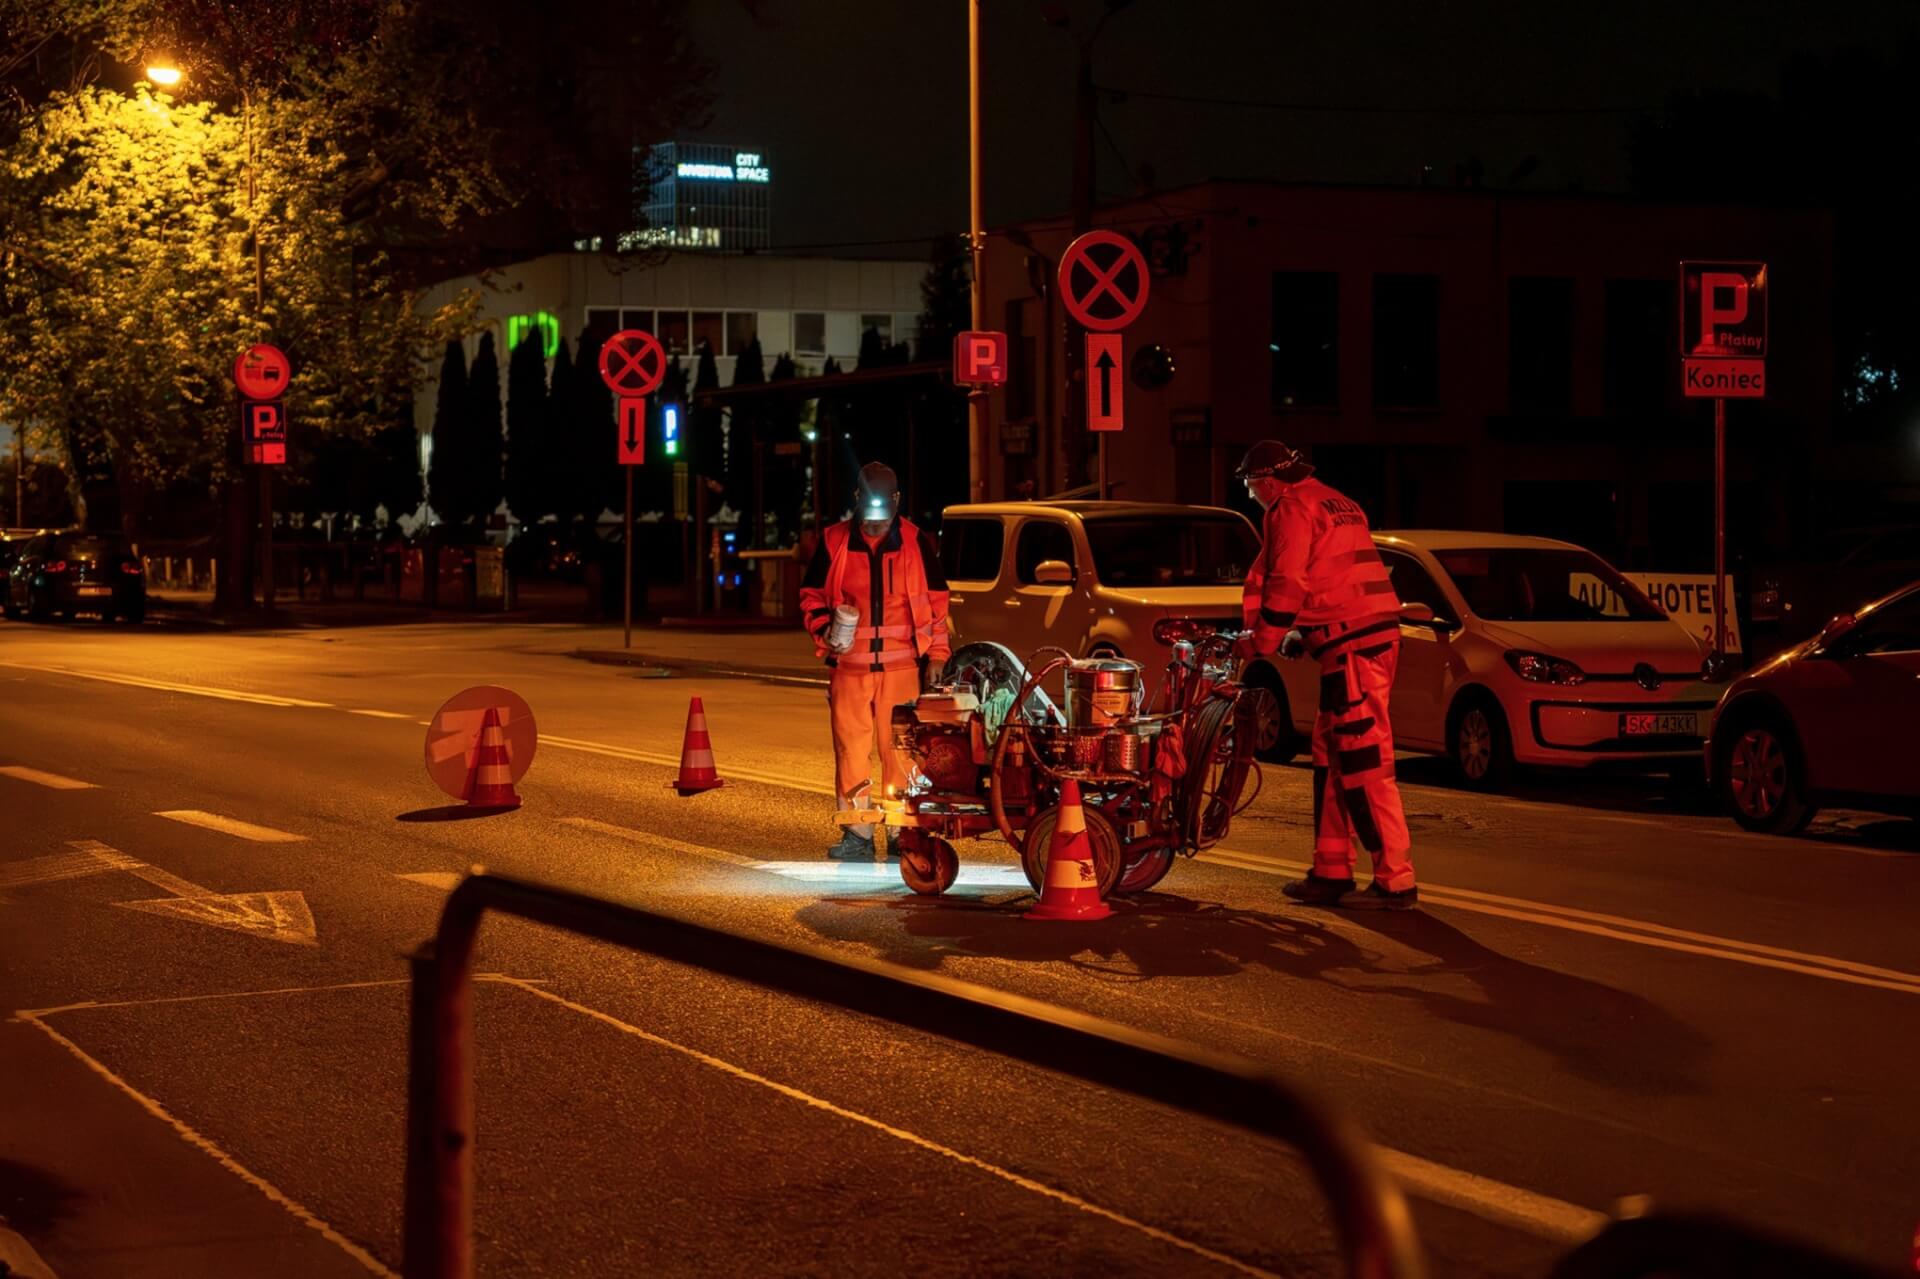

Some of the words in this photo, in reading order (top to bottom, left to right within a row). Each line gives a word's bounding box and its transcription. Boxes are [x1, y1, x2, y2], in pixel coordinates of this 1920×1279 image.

[736, 153, 760, 167] CITY
[736, 167, 769, 183] SPACE
[1702, 272, 1748, 345] P
[970, 339, 996, 376] P
[1687, 367, 1762, 389] Koniec
[253, 405, 277, 438] P
[1578, 583, 1621, 612] AUT
[1648, 583, 1728, 613] HOTEL
[1703, 625, 1736, 646] 2h
[1629, 716, 1647, 732] SK
